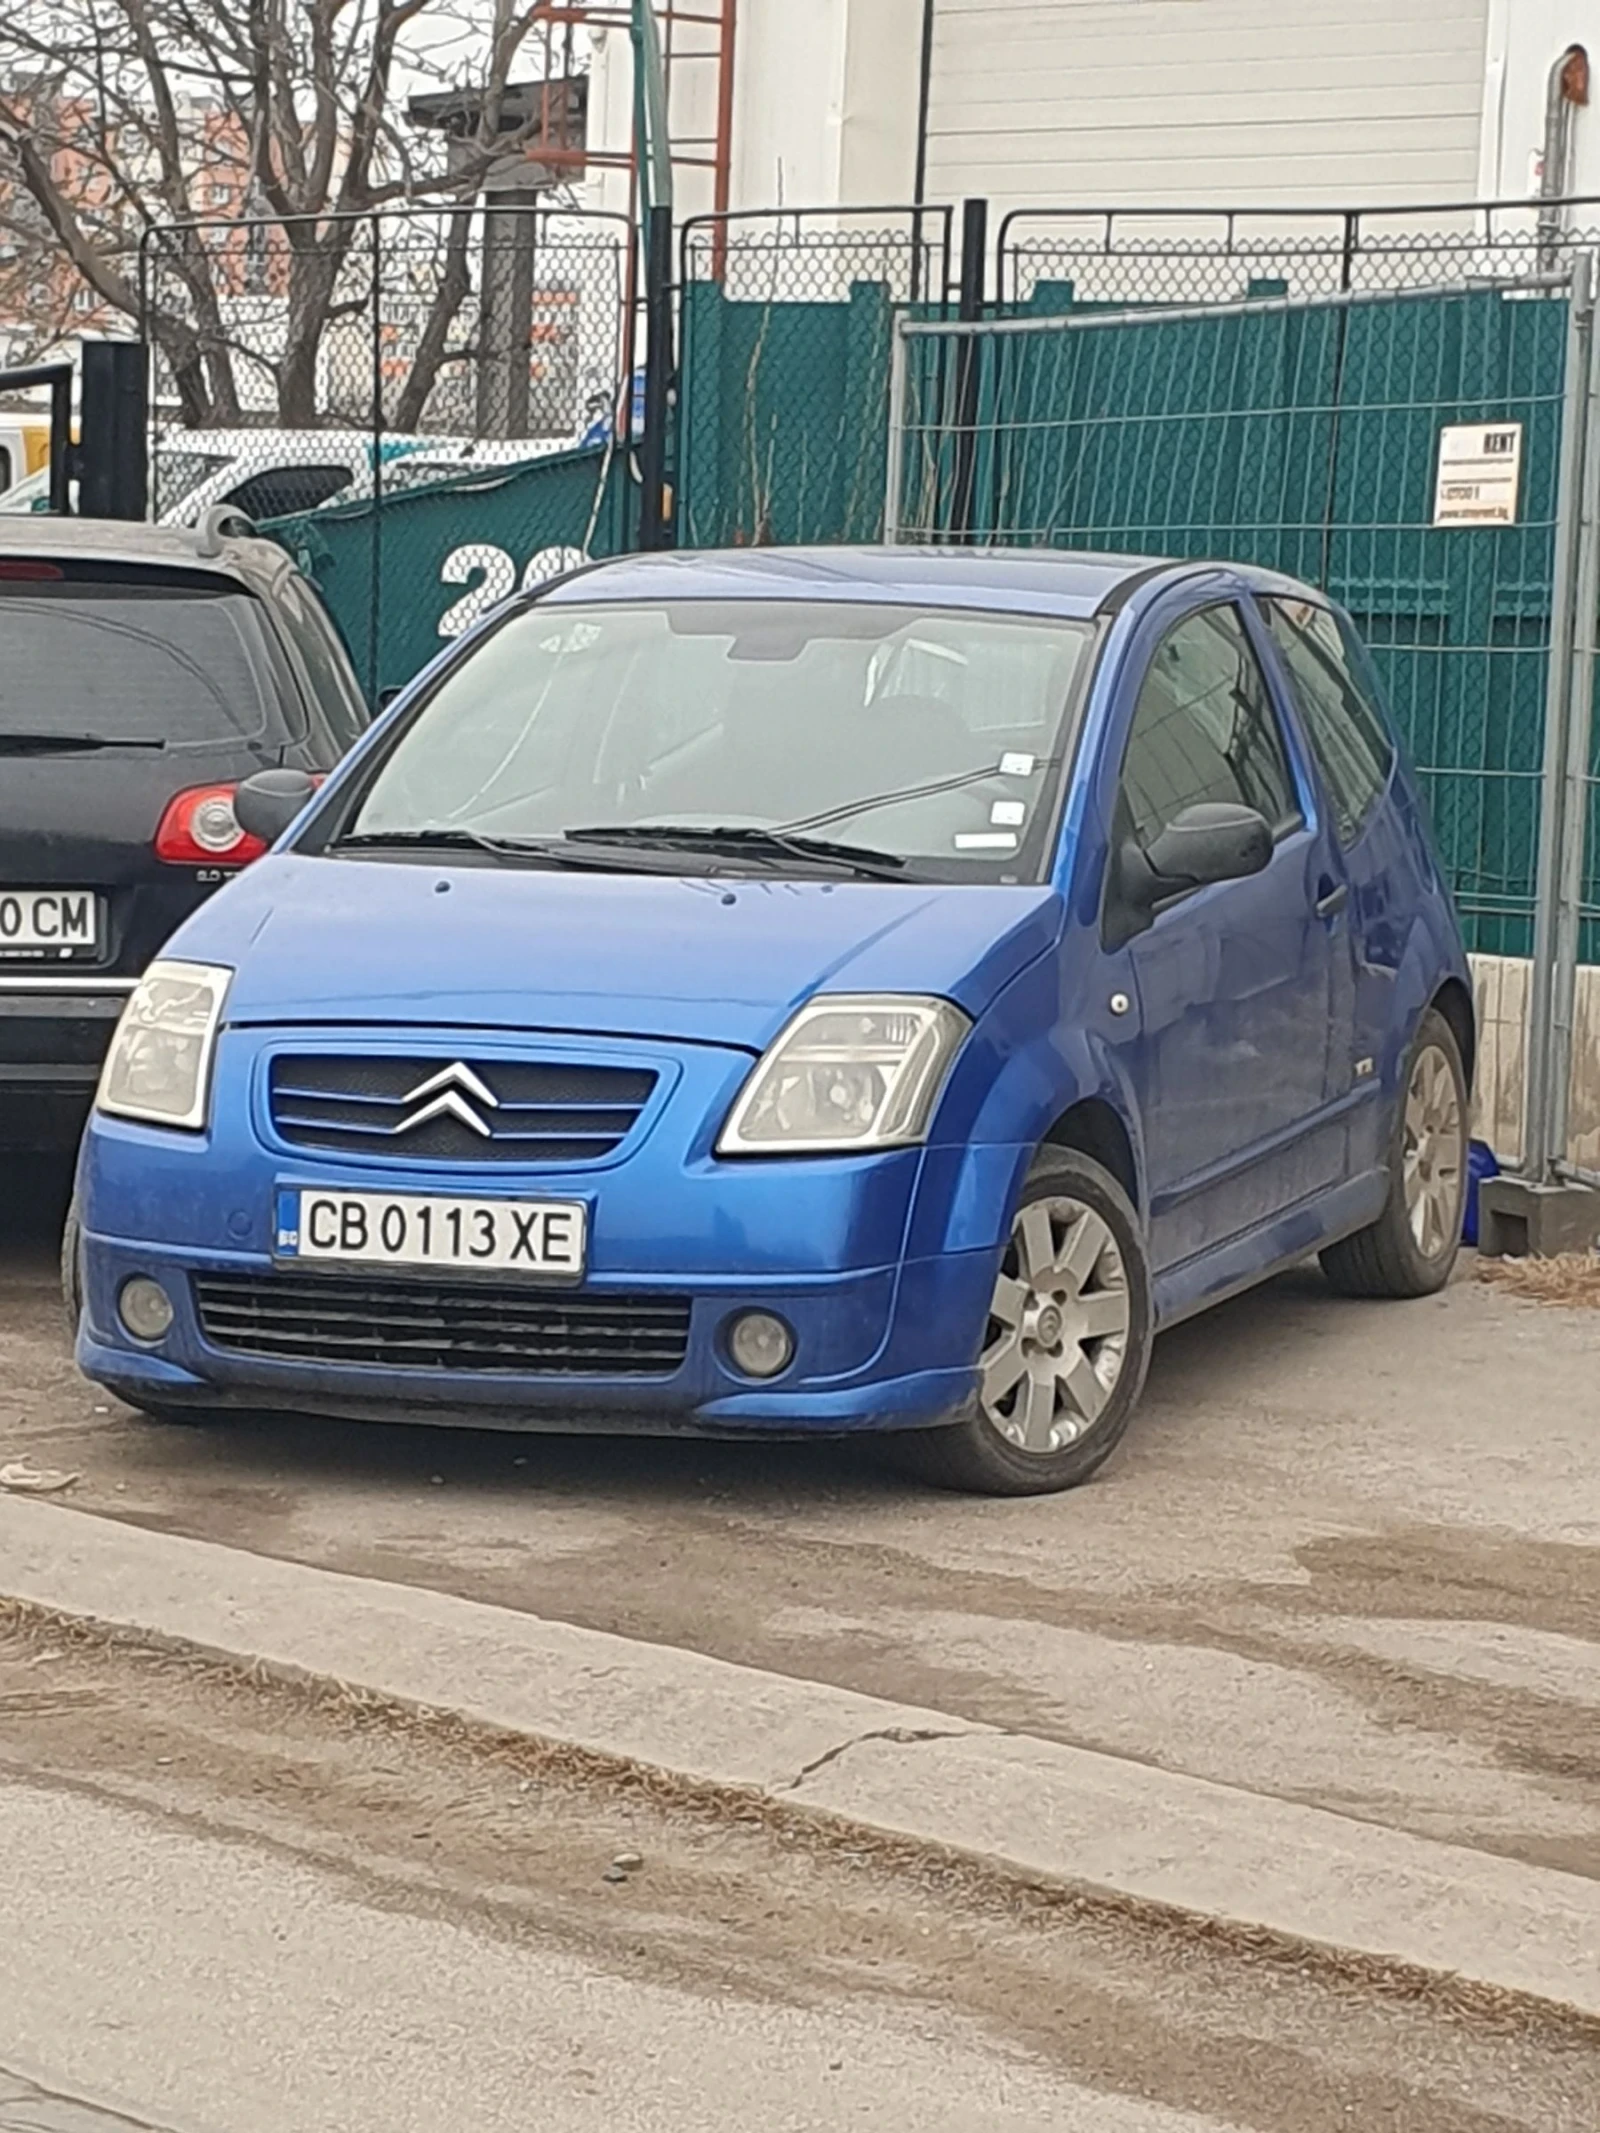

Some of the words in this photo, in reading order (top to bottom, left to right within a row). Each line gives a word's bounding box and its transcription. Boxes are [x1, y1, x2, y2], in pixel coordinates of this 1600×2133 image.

[1484, 432, 1516, 454] RENT
[438, 543, 594, 637] 2
[32, 896, 88, 938] CM
[309, 1200, 368, 1250] CB
[381, 1204, 496, 1257] 0113
[510, 1210, 572, 1262] XE
